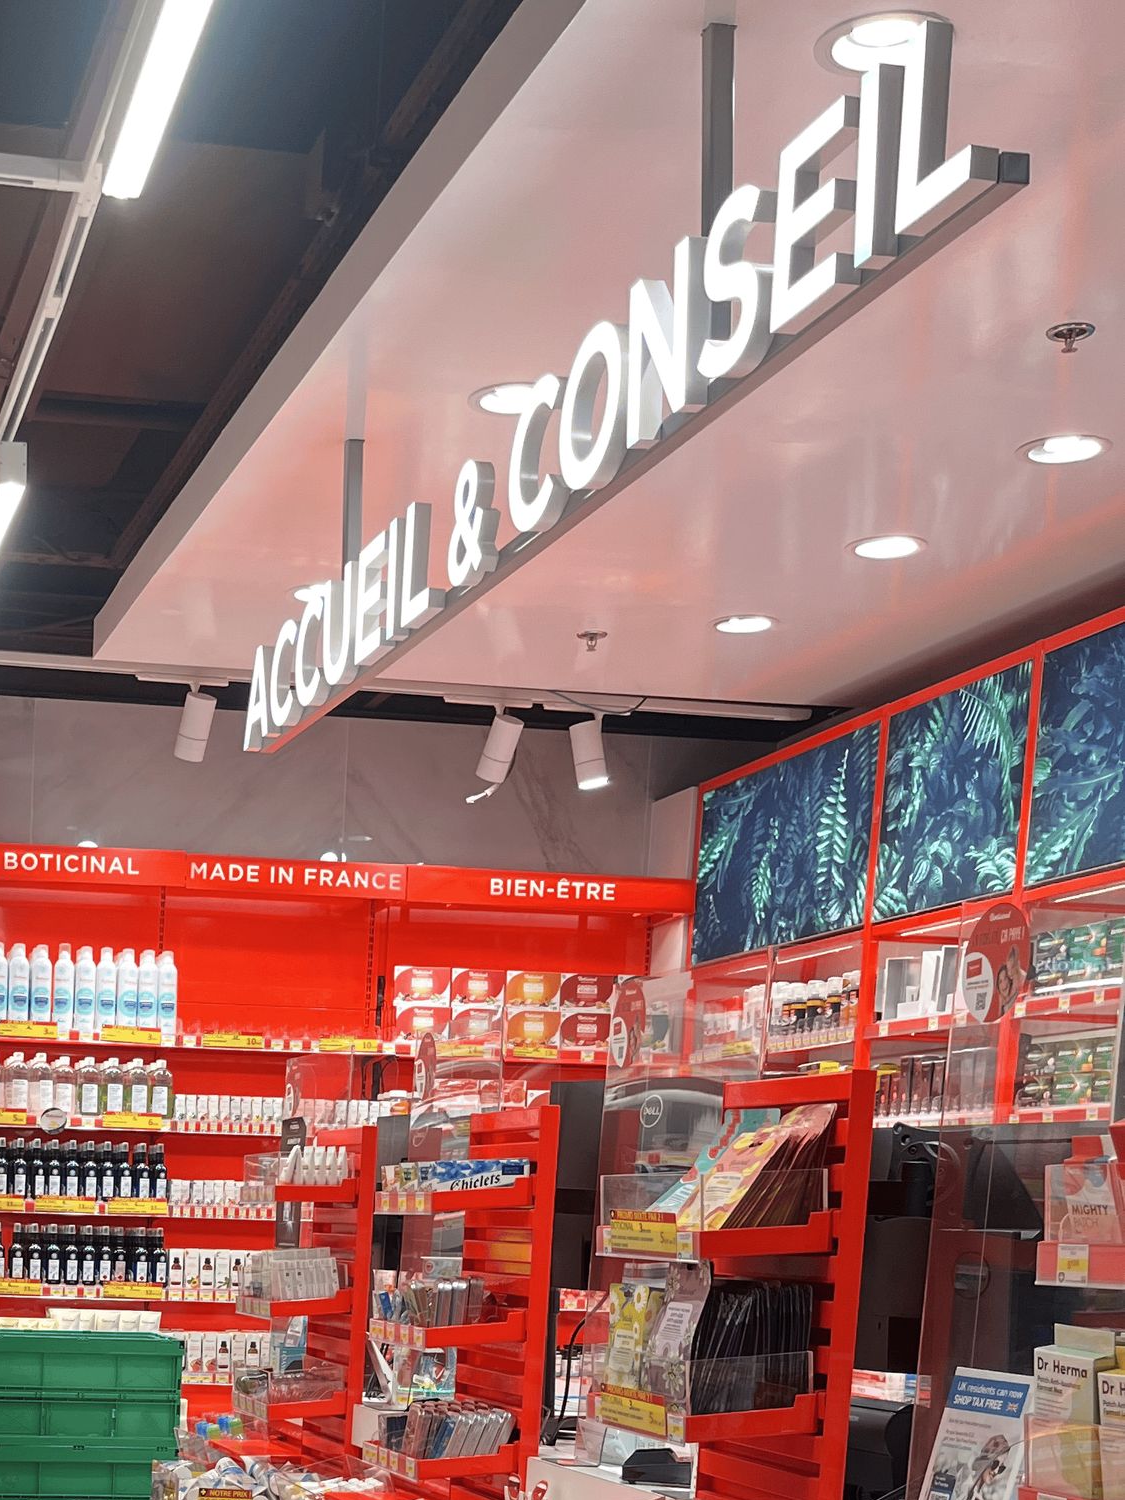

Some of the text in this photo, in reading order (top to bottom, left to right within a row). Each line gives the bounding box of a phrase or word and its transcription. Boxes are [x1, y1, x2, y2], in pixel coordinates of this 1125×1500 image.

[243, 18, 999, 752] ACCUEIL & CONSEIL
[3, 851, 140, 875] BOTICINAL
[190, 861, 402, 891] MADE IN FRANCE
[489, 877, 616, 902] BIEN-ÊTRE
[644, 1106, 660, 1116] DELL
[1072, 1204, 1108, 1215] MIGHTY
[1037, 1357, 1087, 1378] Dr Herma
[996, 1388, 1007, 1396] can
[1102, 1381, 1114, 1395] Dr
[953, 1395, 1004, 1410] SHOP TAX FREE
